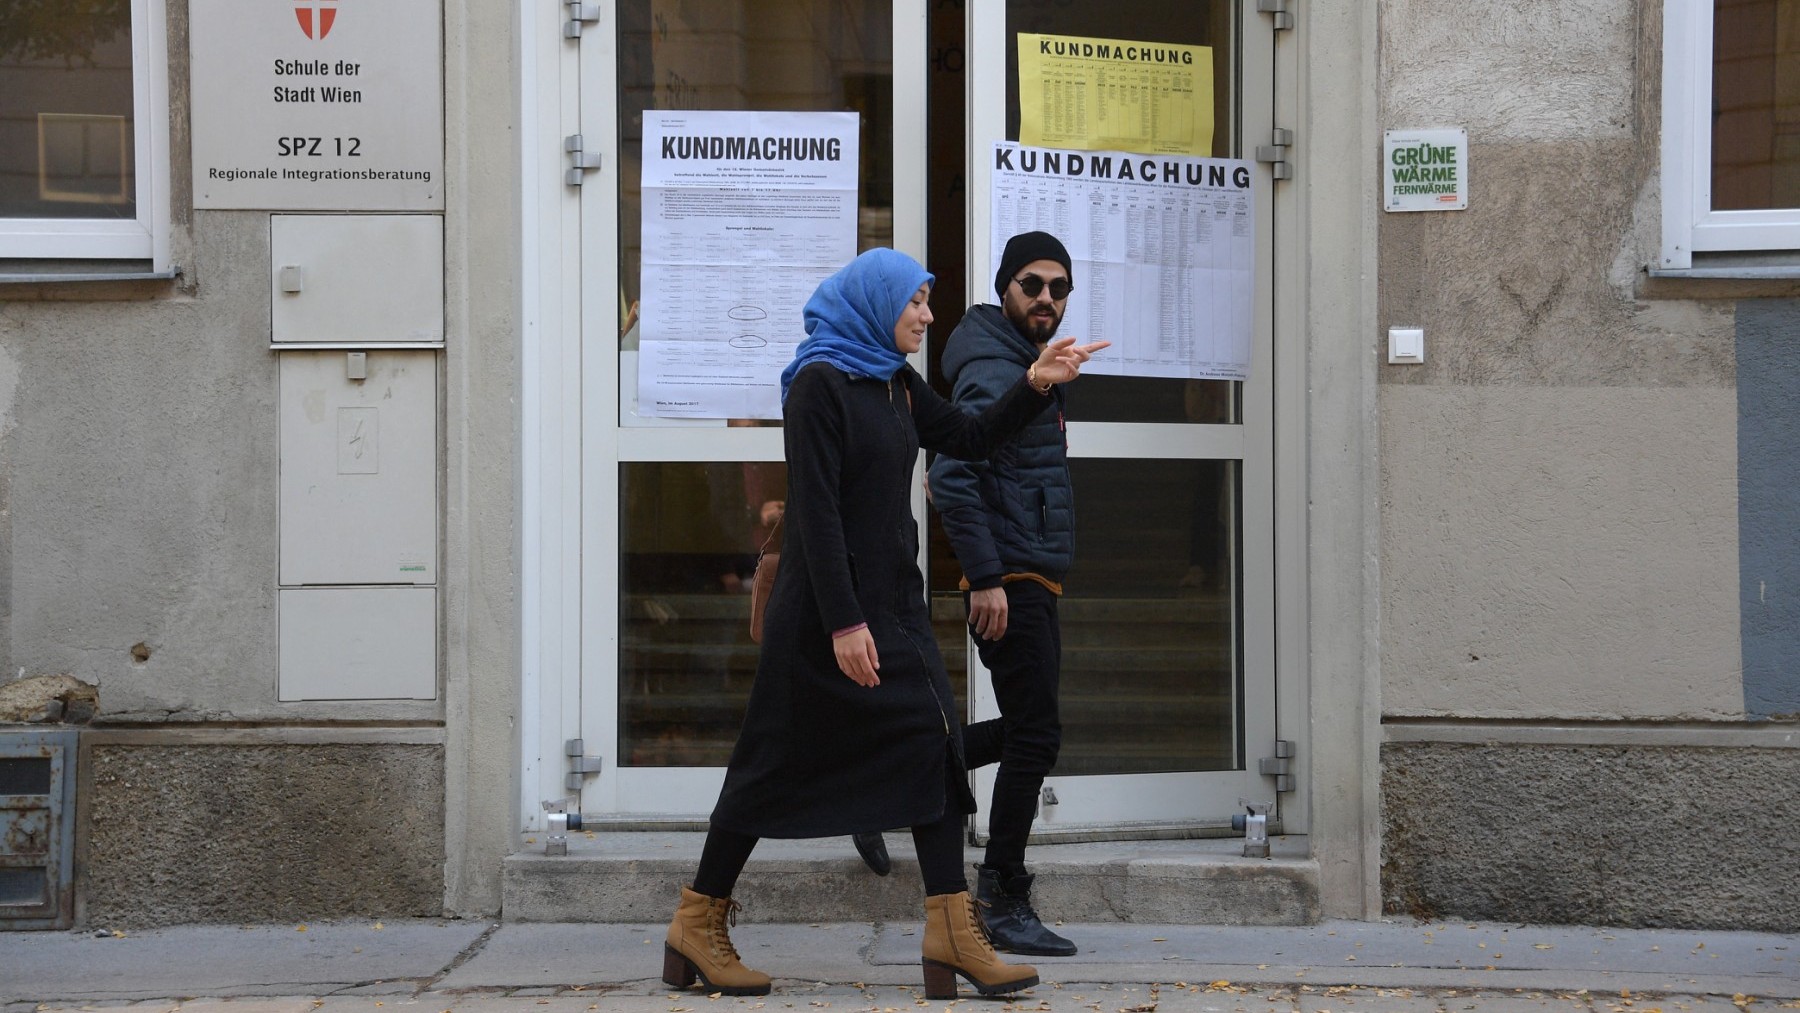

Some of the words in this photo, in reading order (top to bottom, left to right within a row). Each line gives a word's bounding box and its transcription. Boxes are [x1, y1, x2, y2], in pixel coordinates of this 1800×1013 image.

[1040, 40, 1193, 65] KUNDMACHUNG
[274, 59, 329, 76] Schule
[334, 59, 361, 76] der
[274, 86, 315, 103] Stadt
[320, 86, 362, 103] Wien
[277, 137, 322, 157] SPZ
[334, 137, 361, 157] 12
[661, 136, 841, 161] KUNDMACHUNG
[1391, 143, 1457, 166] GRÜNE
[208, 168, 278, 182] Regionale
[282, 168, 431, 182] Integrationsberatung
[995, 148, 1250, 189] KUNDMACHUNG
[1391, 165, 1457, 183] WÄRME
[1393, 183, 1457, 195] FERNWÄRME
